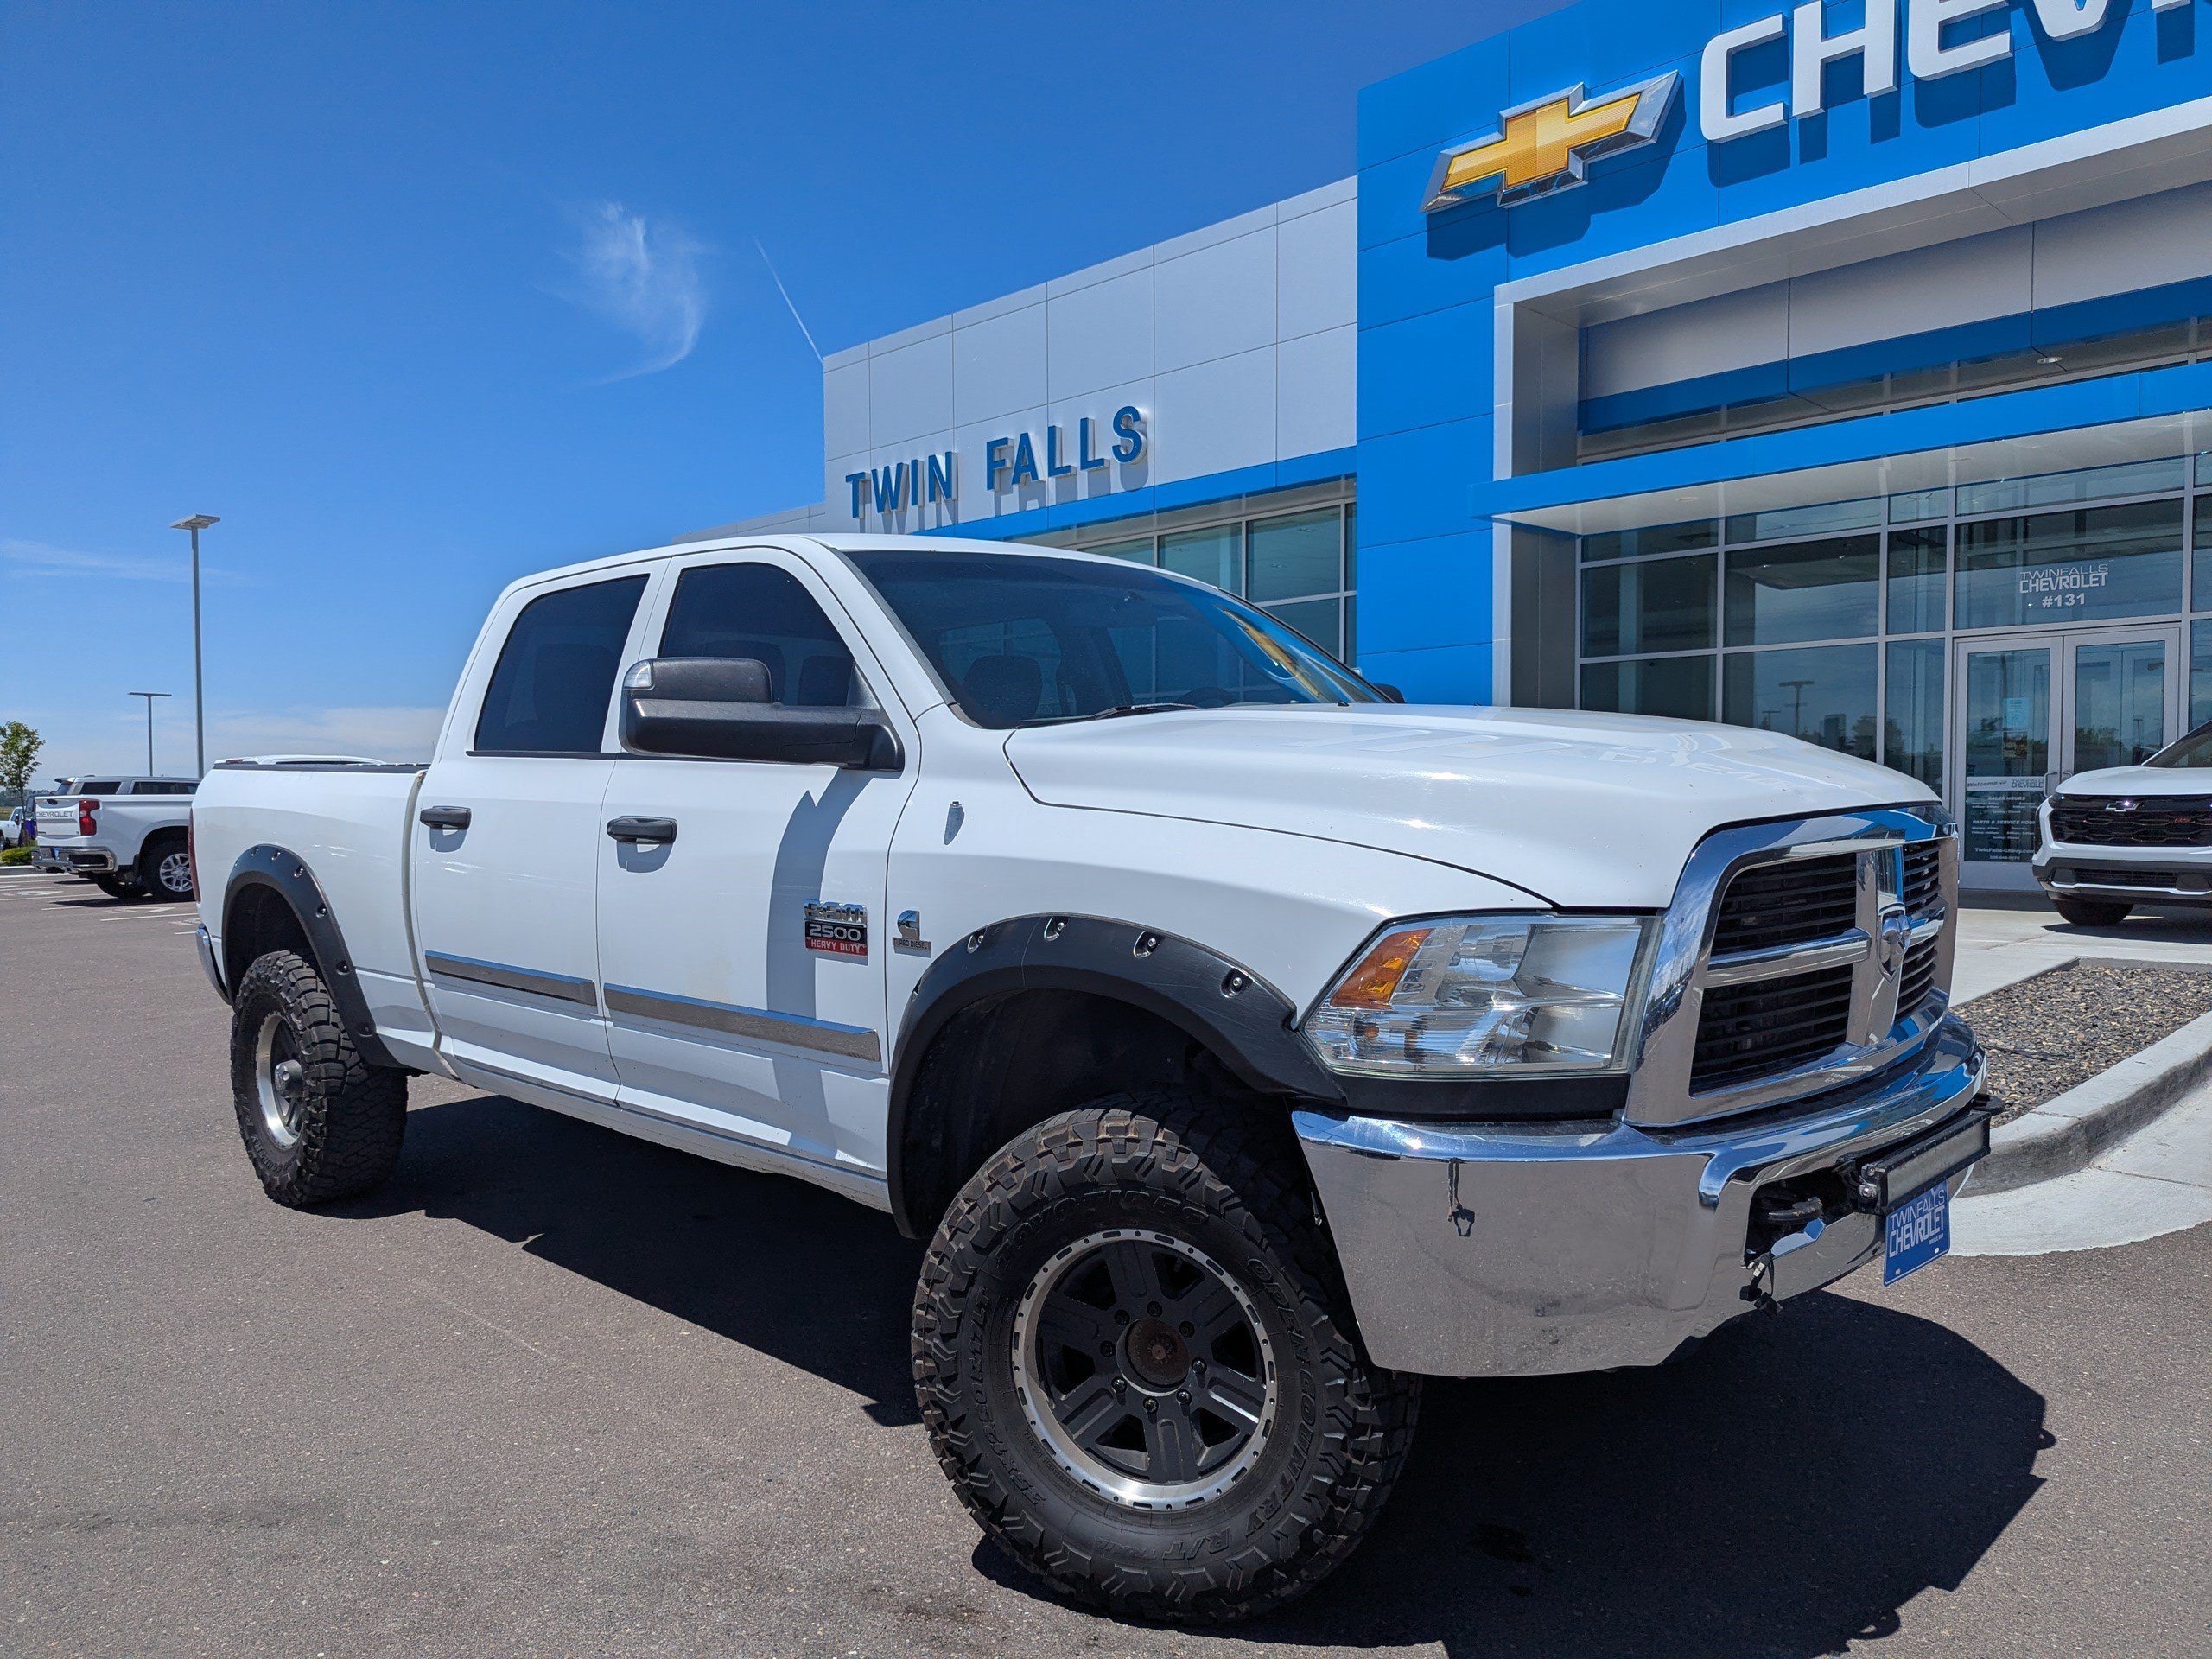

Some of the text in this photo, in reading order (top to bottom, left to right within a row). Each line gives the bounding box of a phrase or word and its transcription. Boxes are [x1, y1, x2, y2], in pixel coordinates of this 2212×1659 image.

[1700, 0, 2190, 143] CHE
[845, 405, 1147, 518] TWIN FALLS
[2020, 563, 2108, 580] TWINFALLS
[2020, 572, 2108, 594] CHEVROLET
[2042, 593, 2085, 608] #131
[809, 923, 861, 942] 2500
[810, 939, 861, 954] HEAVY DUTY
[910, 940, 928, 950] DIESEL
[1891, 1189, 1945, 1230] TWINFALLS
[1889, 1205, 1945, 1258] CHEVROLET
[1247, 1258, 1311, 1364] OPEN
[1246, 1369, 1316, 1538] COUNTRY
[1162, 1526, 1230, 1561] R/T
